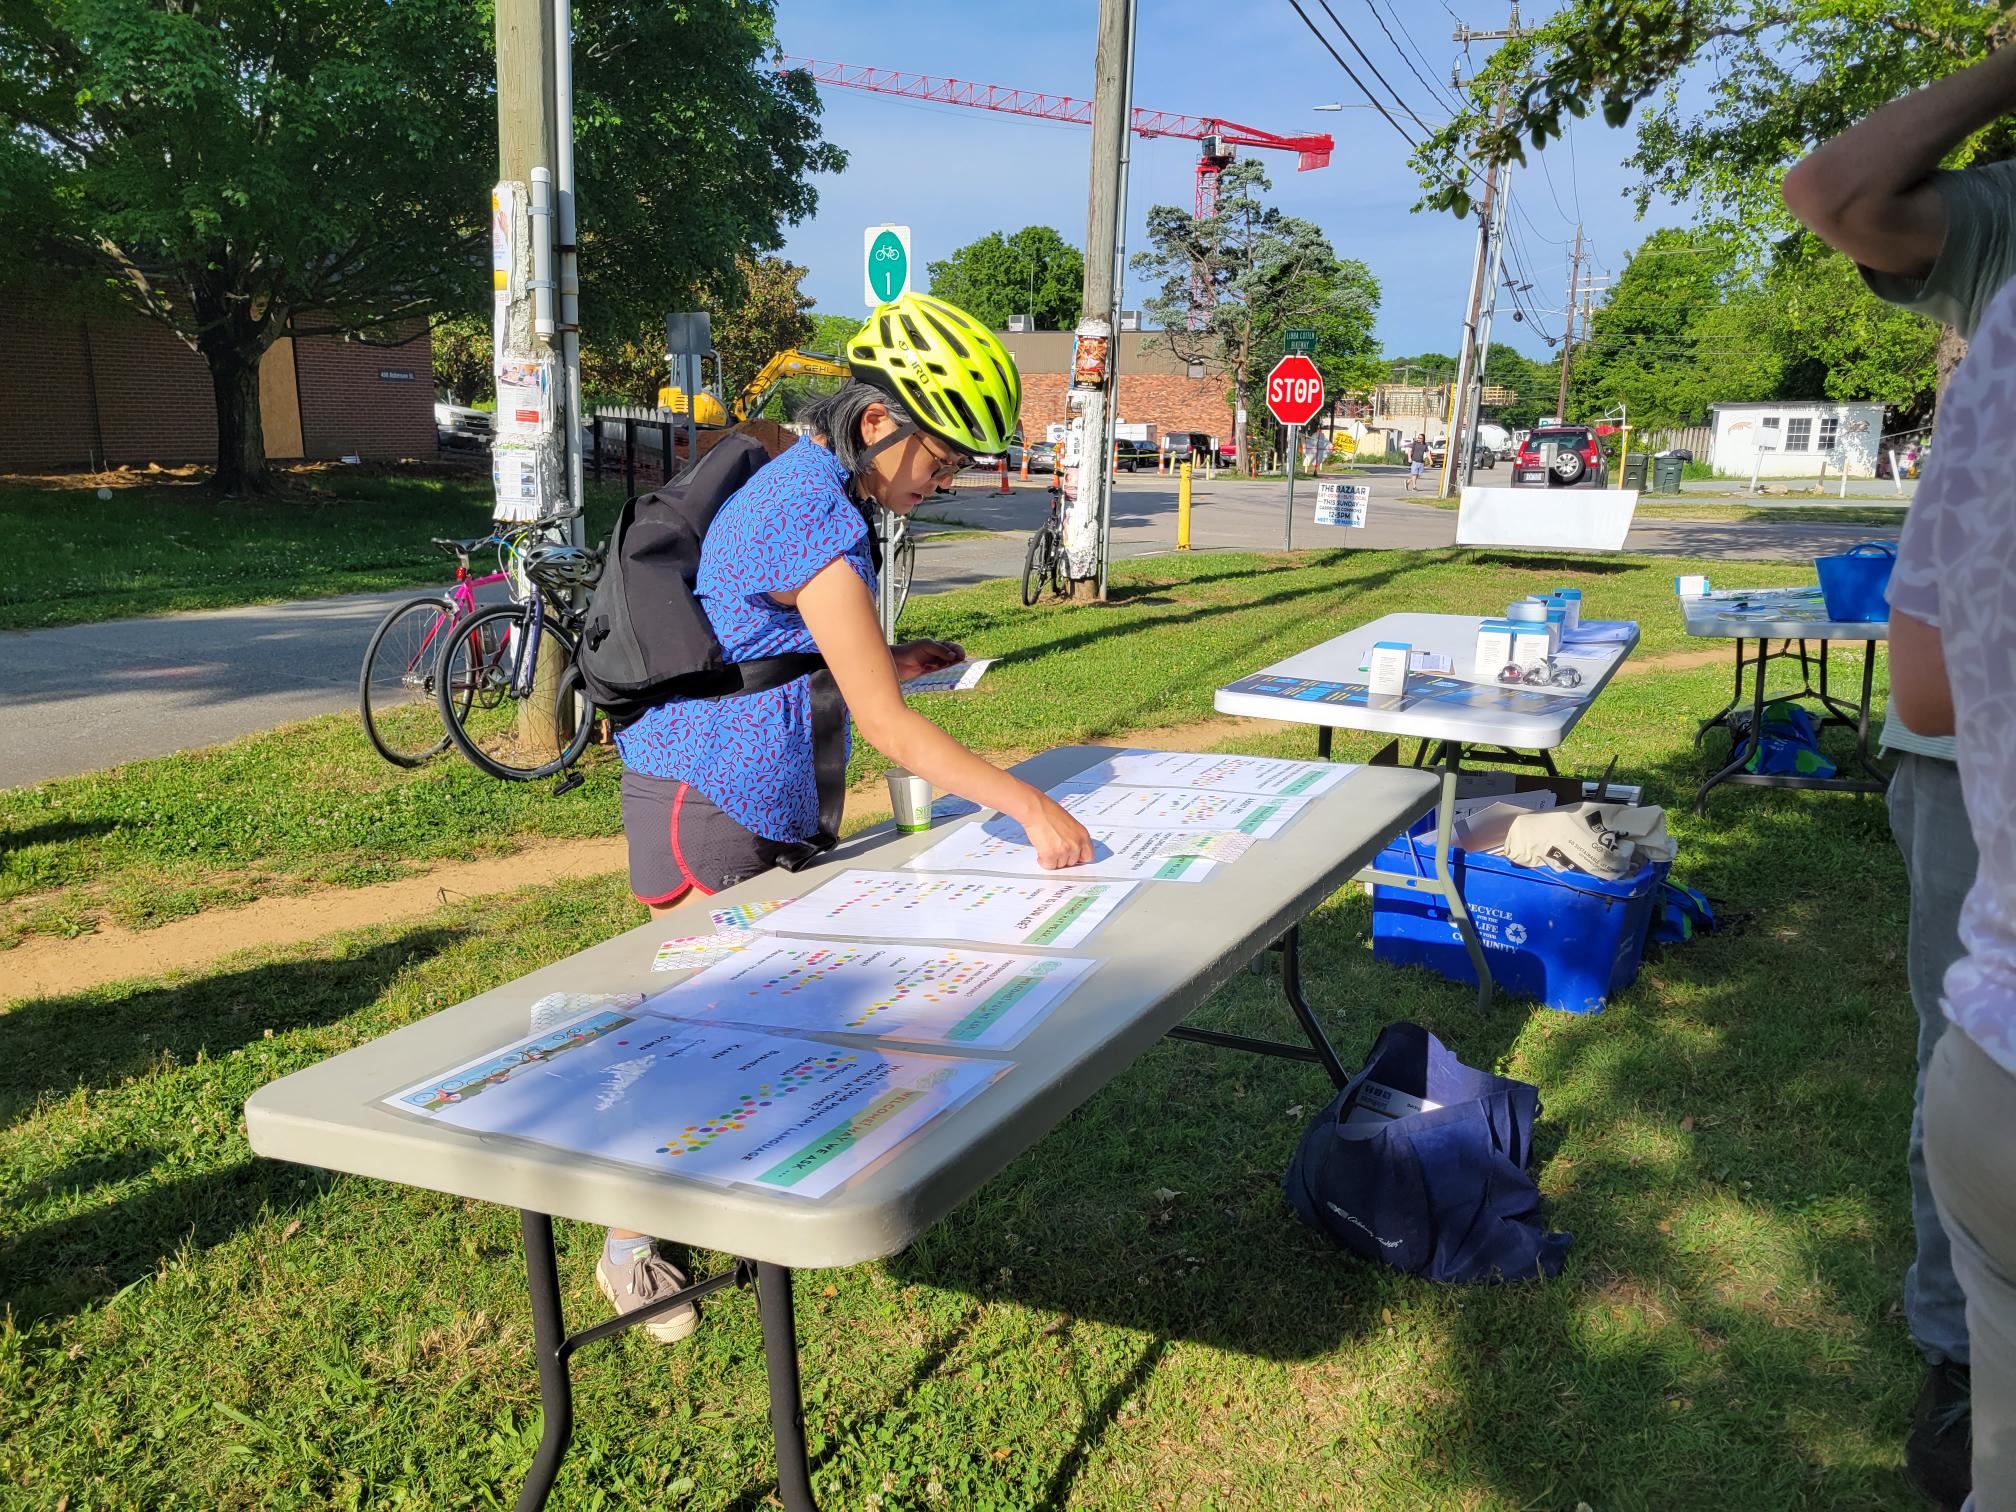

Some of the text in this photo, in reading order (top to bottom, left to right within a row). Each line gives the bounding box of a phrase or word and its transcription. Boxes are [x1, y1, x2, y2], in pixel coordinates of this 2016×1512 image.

[884, 272, 892, 296] 1
[804, 364, 830, 373] GEHL
[1271, 378, 1320, 404] STOP
[1336, 486, 1366, 495] BAZAAR
[1052, 886, 1074, 898] WHAT
[1029, 904, 1052, 916] YOUR
[1467, 903, 1512, 920] ECYCLE
[1015, 916, 1034, 929] AGE?
[1476, 921, 1499, 933] LIFE
[639, 1036, 671, 1050] OTHER
[712, 1044, 742, 1059] KAREN
[737, 1050, 780, 1071] BURMESE
[780, 1057, 818, 1076] SPANISH
[819, 1064, 858, 1083] ENGLISH
[853, 1063, 889, 1082] SPOKEN
[872, 1066, 903, 1080] WHAT
[808, 1091, 842, 1110] HOME?
[837, 1088, 864, 1102] YOUR
[797, 1102, 839, 1127] PRIMARY
[860, 1091, 912, 1126] WELCOME!
[836, 1126, 860, 1142] MAY
[741, 1128, 798, 1160] LANGUAGE
[816, 1144, 838, 1154] WE
[792, 1155, 817, 1169] ASK
